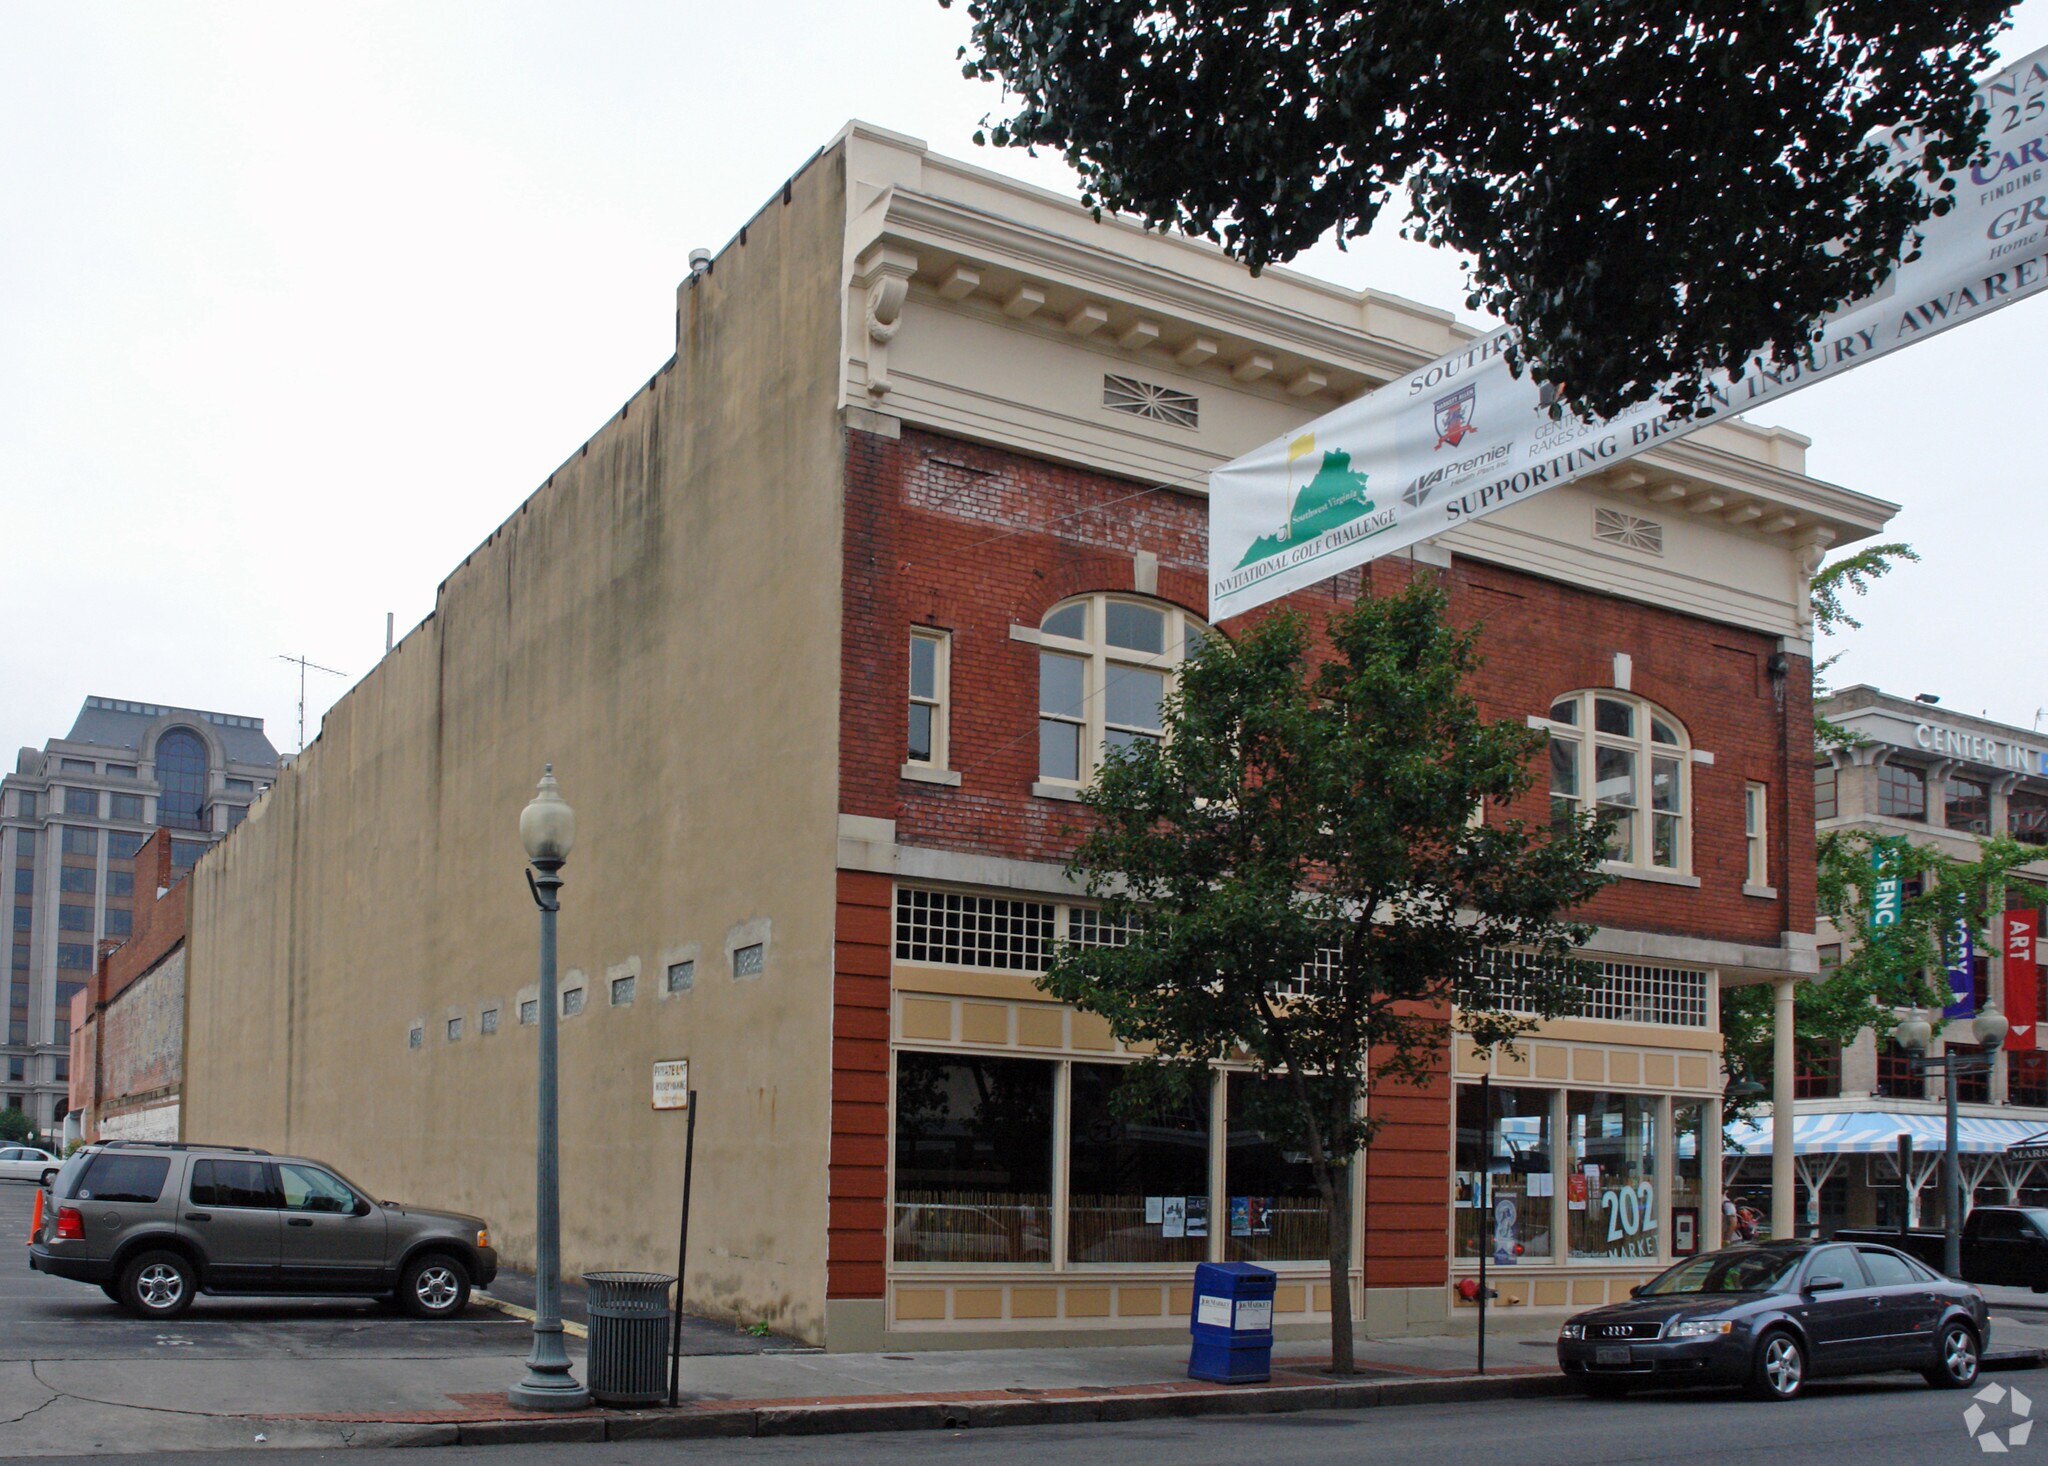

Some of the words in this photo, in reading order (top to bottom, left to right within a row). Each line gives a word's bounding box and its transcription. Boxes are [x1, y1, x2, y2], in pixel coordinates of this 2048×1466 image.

[1971, 138, 2048, 186] CAR
[1980, 169, 2041, 206] FINDING
[1987, 195, 2048, 240] GR
[1989, 233, 2038, 261] Home
[1446, 434, 1617, 521] SUPPORTING
[1894, 252, 2048, 339] AWARE
[1528, 428, 1575, 458] RAKES
[1577, 422, 1589, 436] &
[1214, 555, 1289, 597] INVITATIONAL
[1291, 539, 1323, 563] GOLF
[1325, 507, 1397, 550] CHALLENGE
[1915, 724, 1998, 765] CENTER
[2005, 745, 2030, 771] IN
[2009, 920, 2031, 961] ART
[2010, 1148, 2048, 1160] MARK
[1601, 1181, 1658, 1243] 202
[1608, 1235, 1660, 1263] MARKET
